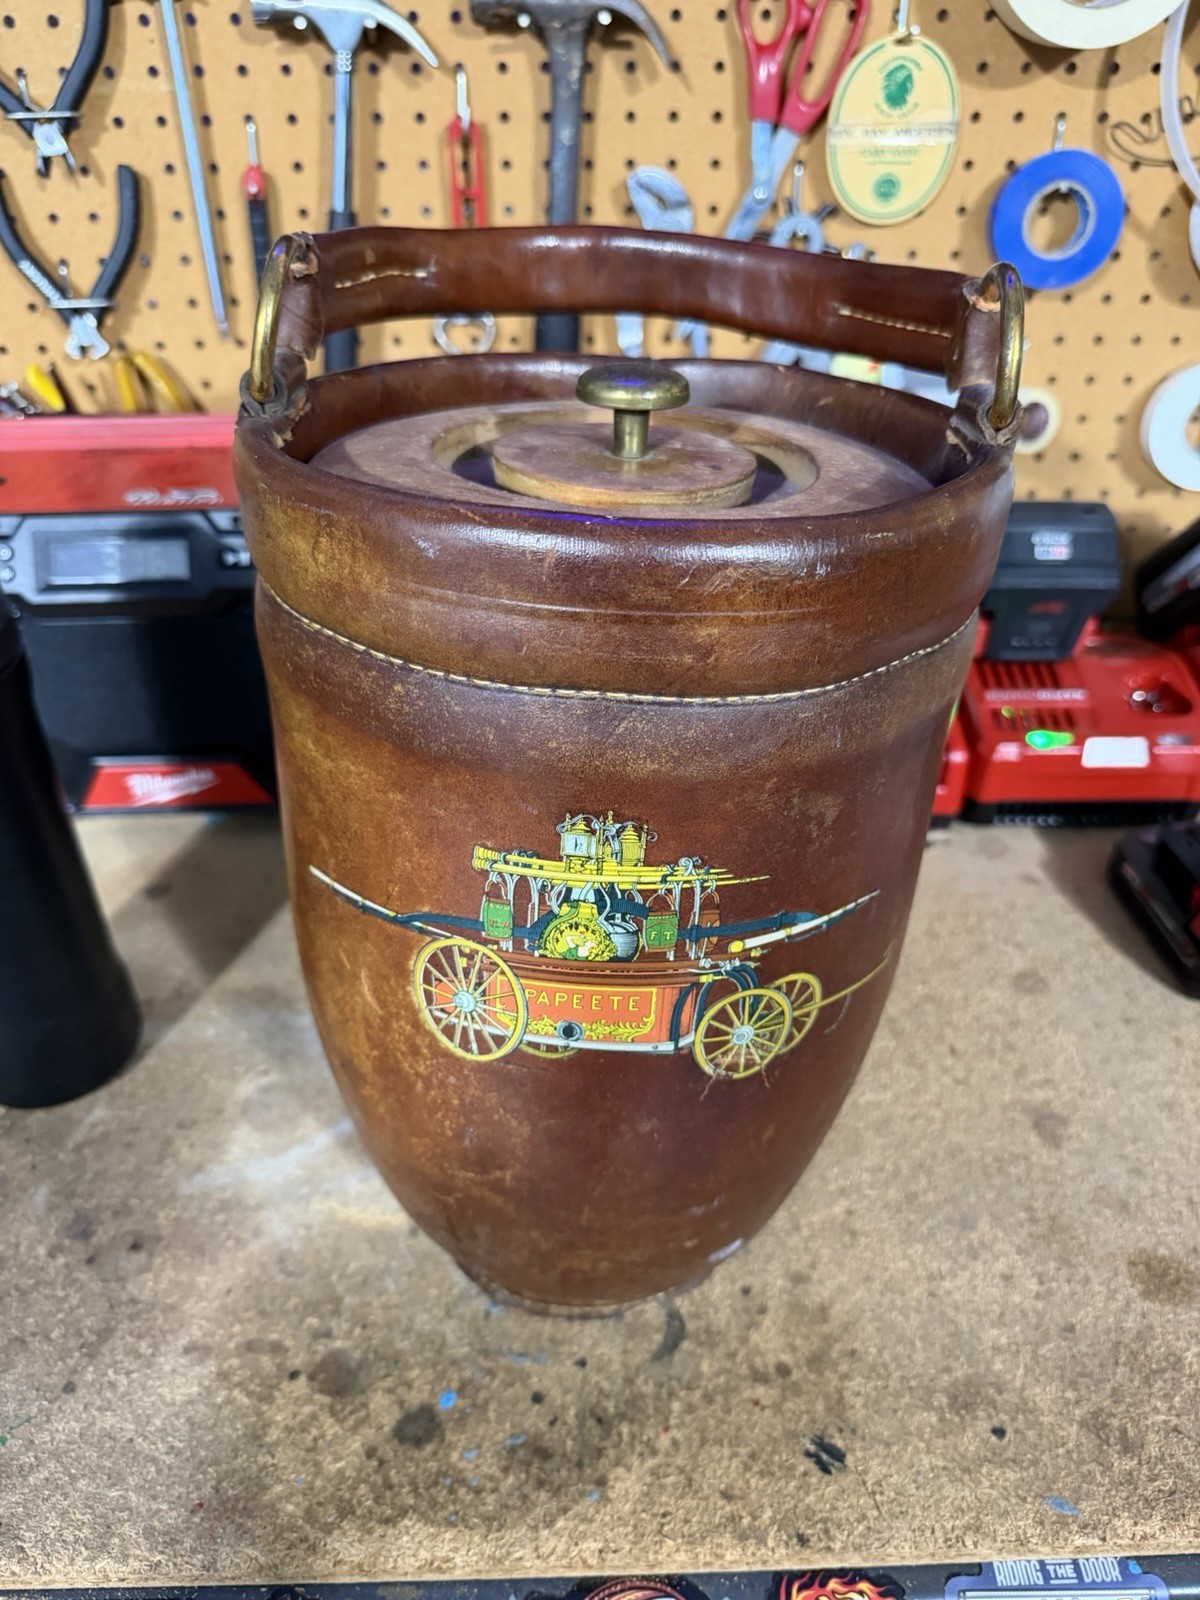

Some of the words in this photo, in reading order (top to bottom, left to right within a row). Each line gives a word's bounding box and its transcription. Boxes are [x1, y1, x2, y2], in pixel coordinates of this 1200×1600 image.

[525, 988, 641, 1011] PAPEETE
[993, 1560, 1044, 1587] RIDING
[1046, 1564, 1077, 1578] THE
